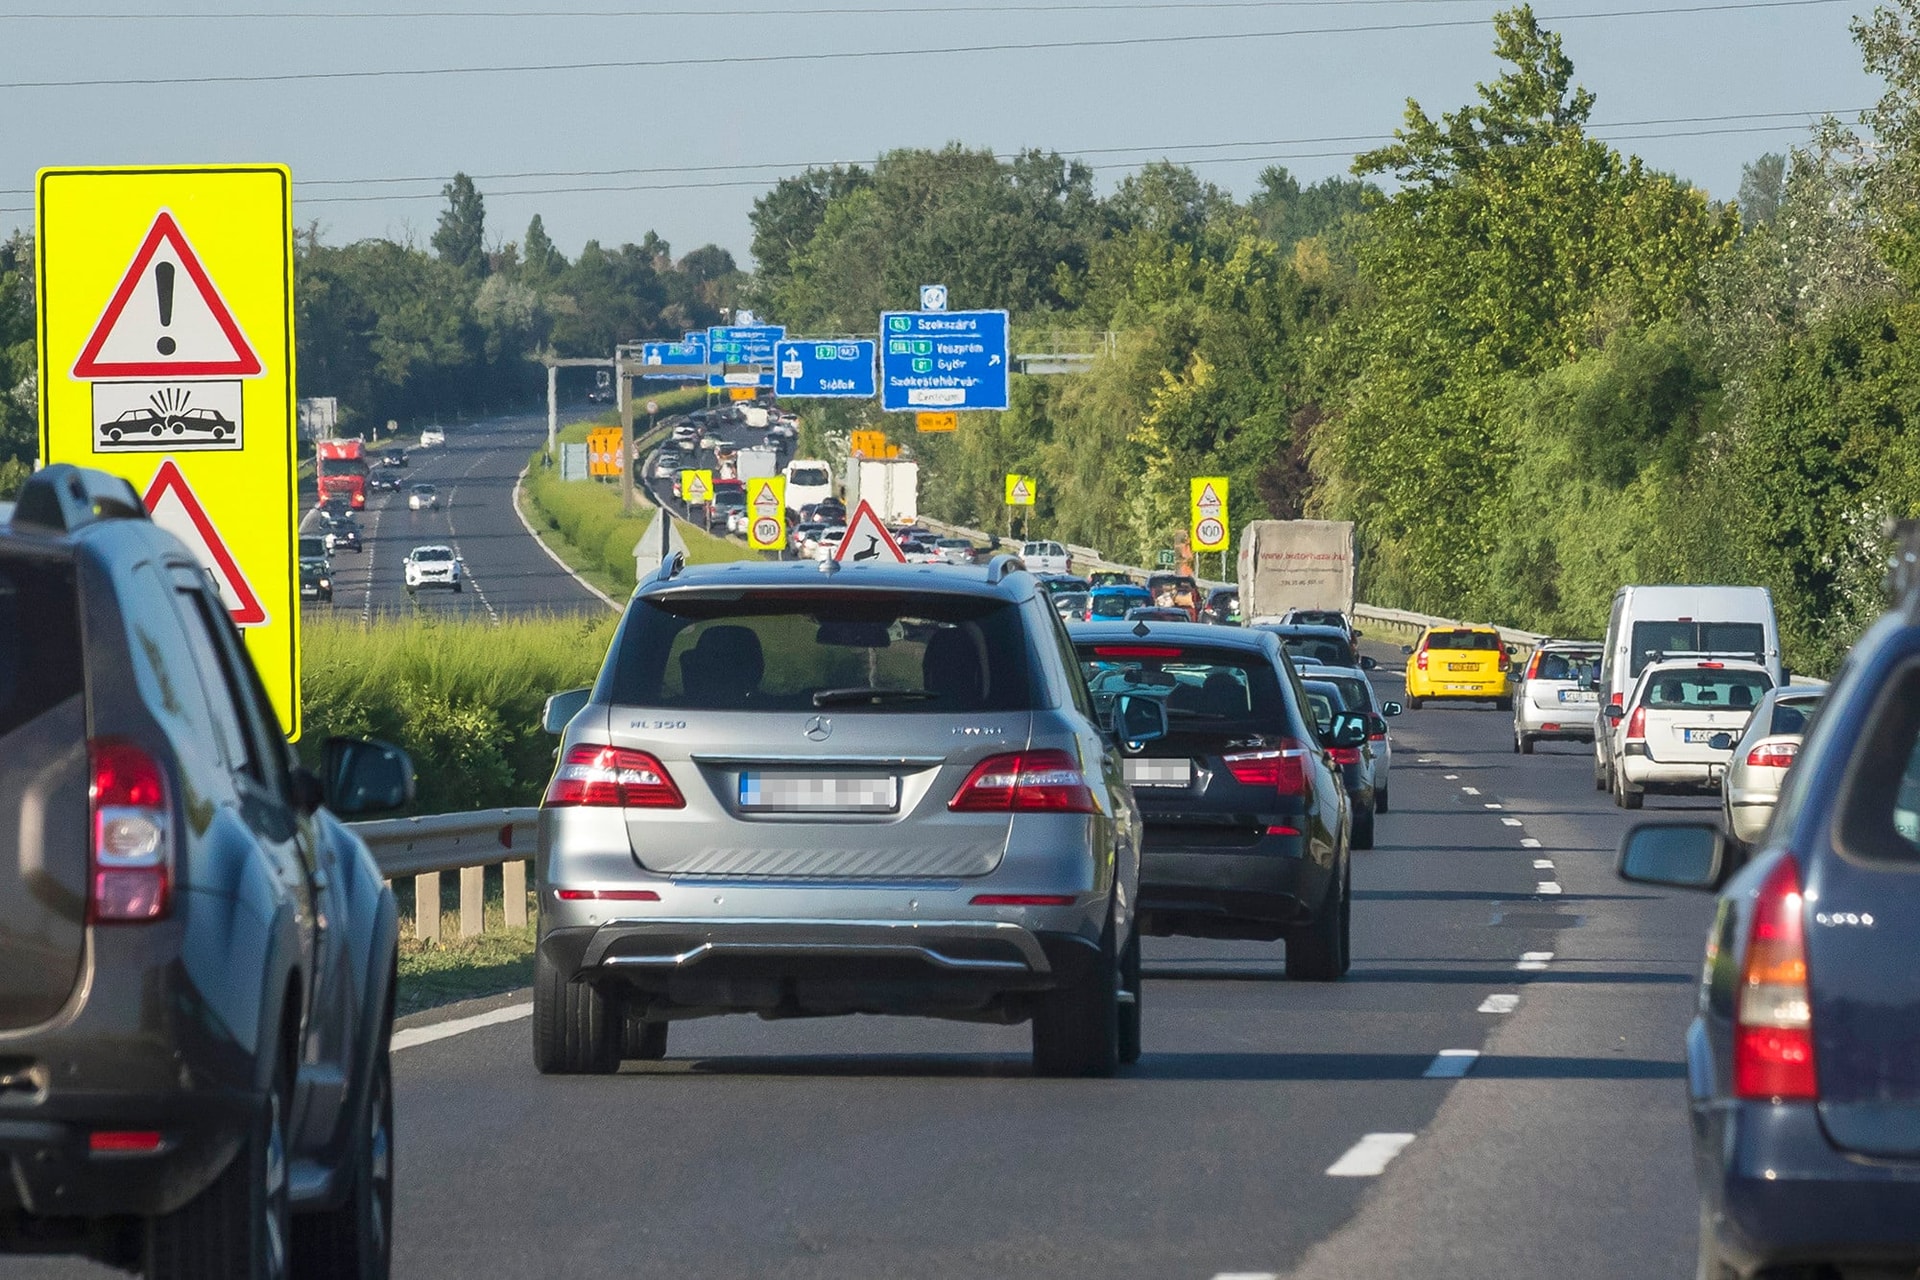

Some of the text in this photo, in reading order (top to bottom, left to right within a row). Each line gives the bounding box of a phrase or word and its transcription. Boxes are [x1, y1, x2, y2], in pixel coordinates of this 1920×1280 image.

[758, 523, 776, 536] 100
[1201, 525, 1220, 537] 100
[653, 720, 687, 729] 350
